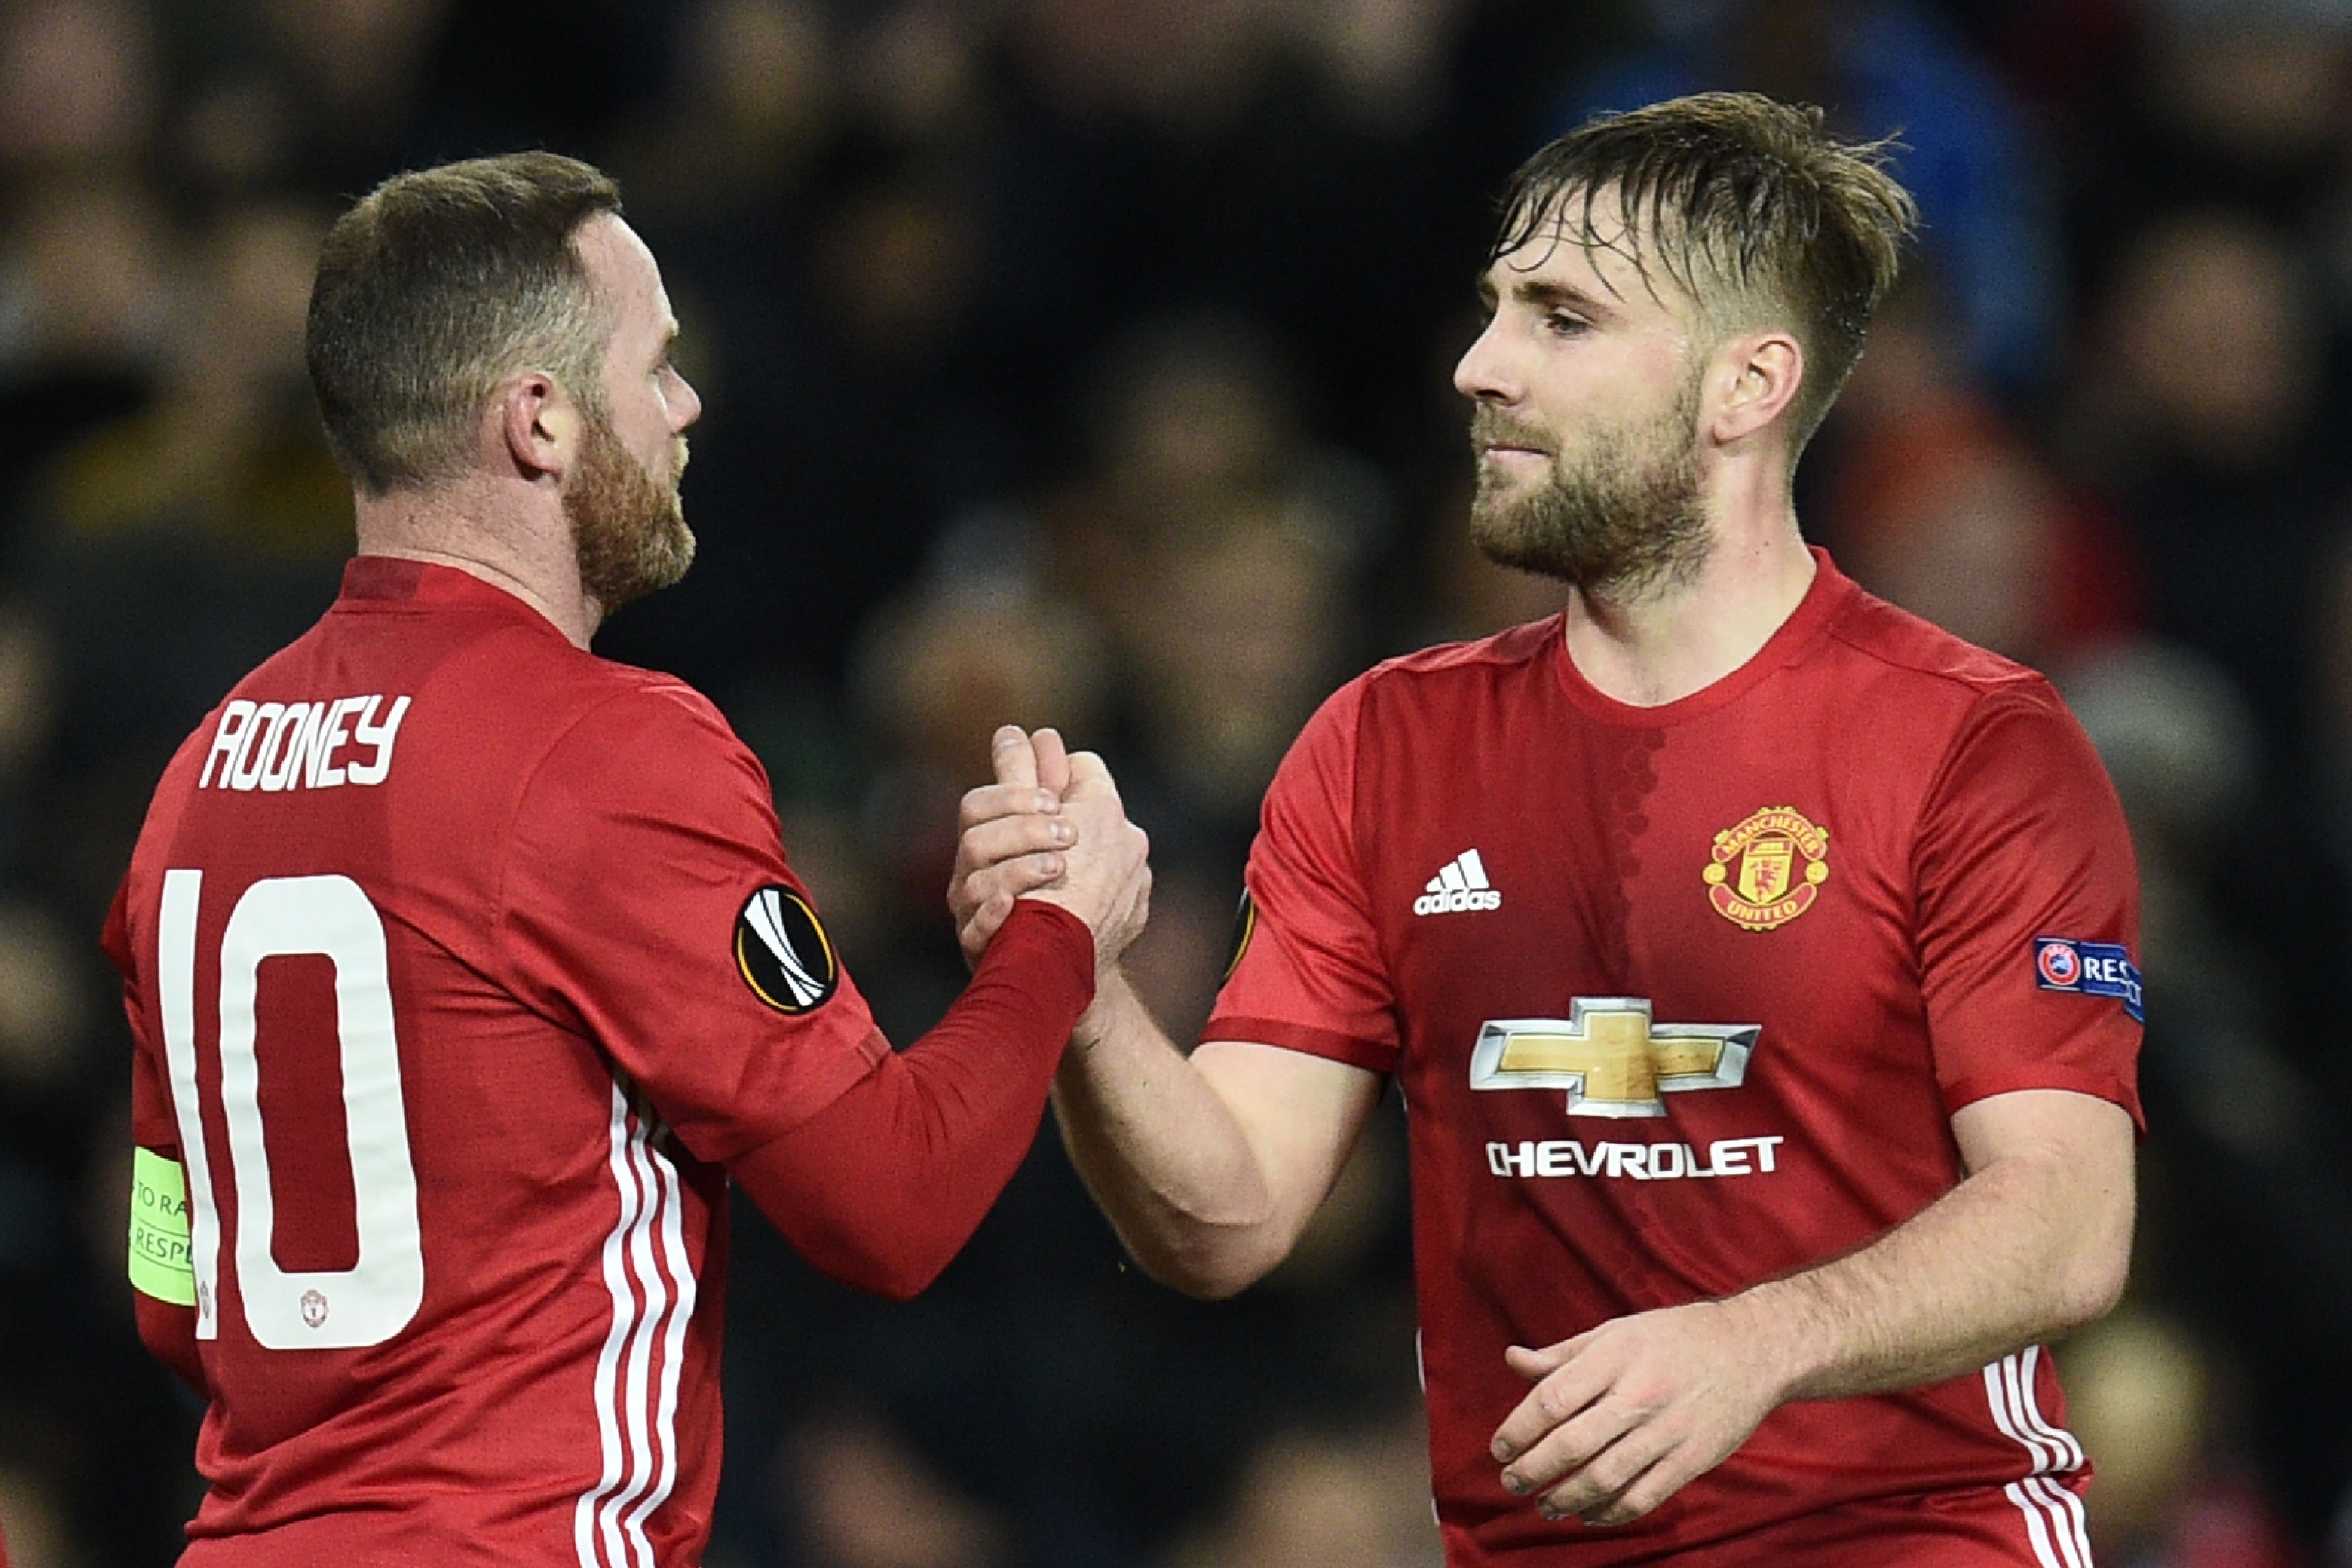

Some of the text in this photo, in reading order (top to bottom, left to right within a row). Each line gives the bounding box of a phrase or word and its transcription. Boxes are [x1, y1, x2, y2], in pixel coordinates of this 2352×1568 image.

[199, 694, 411, 791] ROONEY
[1413, 888, 1501, 915] adidas
[1728, 900, 1797, 920] UNITED
[159, 869, 423, 1349] 10
[1486, 1136, 1783, 1179] CHEVROLET
[138, 1181, 155, 1207] TO
